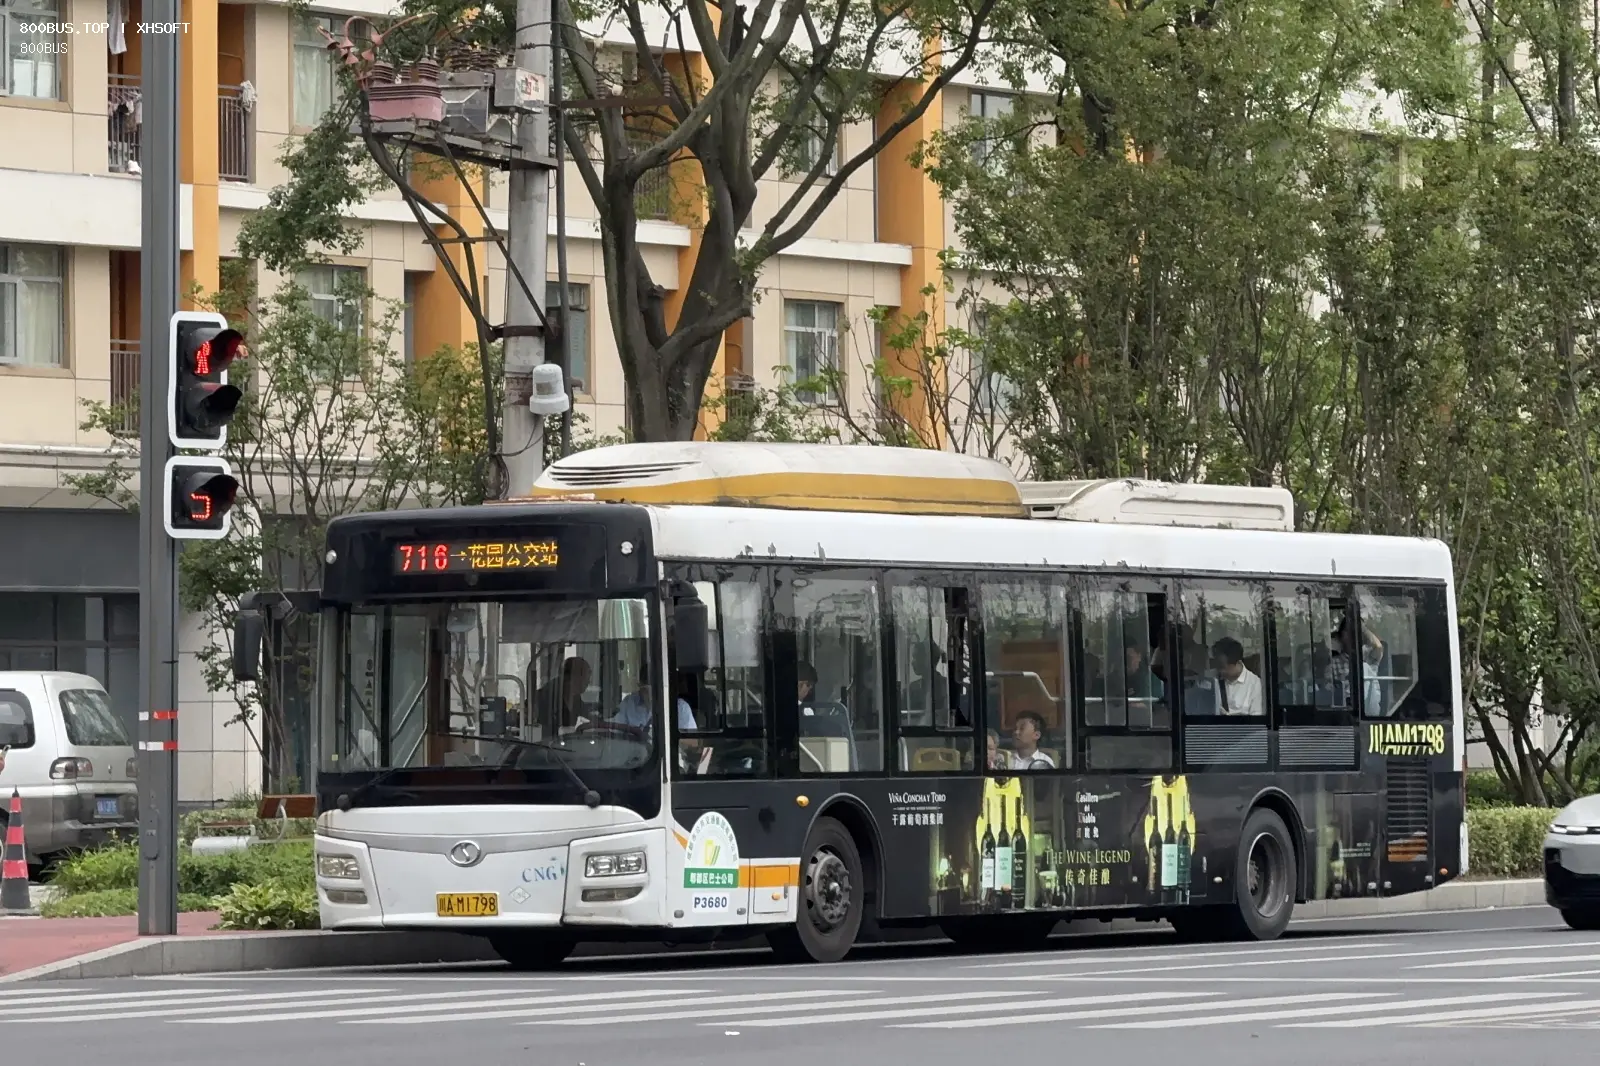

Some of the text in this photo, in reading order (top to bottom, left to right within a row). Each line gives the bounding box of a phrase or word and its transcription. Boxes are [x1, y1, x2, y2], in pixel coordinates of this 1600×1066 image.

[400, 541, 558, 571] 716 花园公交站
[1066, 849, 1092, 864] WINE
[1095, 849, 1131, 864] LEGEND
[522, 866, 557, 883] CNG
[693, 896, 728, 909] P3680
